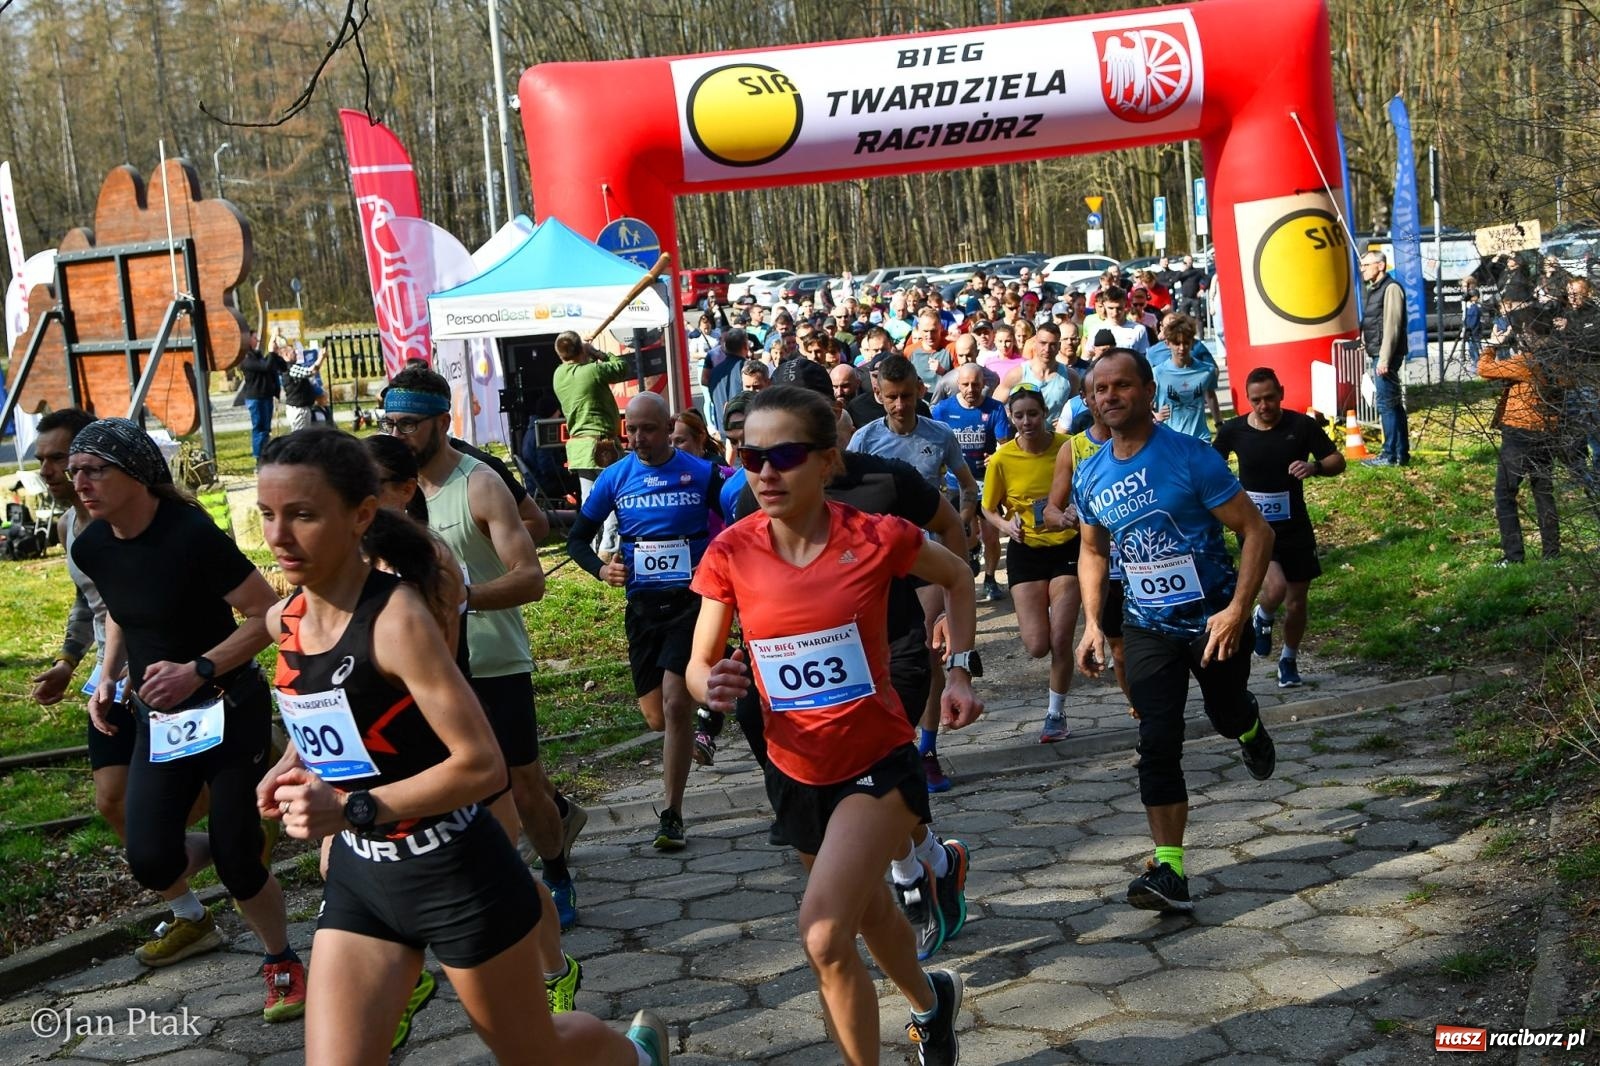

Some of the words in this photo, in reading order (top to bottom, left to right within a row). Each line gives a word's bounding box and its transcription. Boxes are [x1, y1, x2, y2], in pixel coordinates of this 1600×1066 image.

[897, 42, 985, 69] BIEG
[738, 73, 798, 96] SIR
[827, 69, 1067, 117] TWARDZIELA
[854, 112, 1044, 155] RACIBÓRZ
[1304, 223, 1347, 250] SIR
[446, 308, 531, 326] PersonalBest
[1089, 468, 1148, 517] MORSY
[644, 555, 680, 571] 067
[1141, 574, 1186, 595] 030
[759, 645, 772, 653] XIV
[774, 643, 795, 652] BIEG
[796, 632, 851, 649] TWARDZIELA
[779, 656, 848, 691] 063
[167, 720, 208, 746] 02
[292, 723, 344, 757] 090
